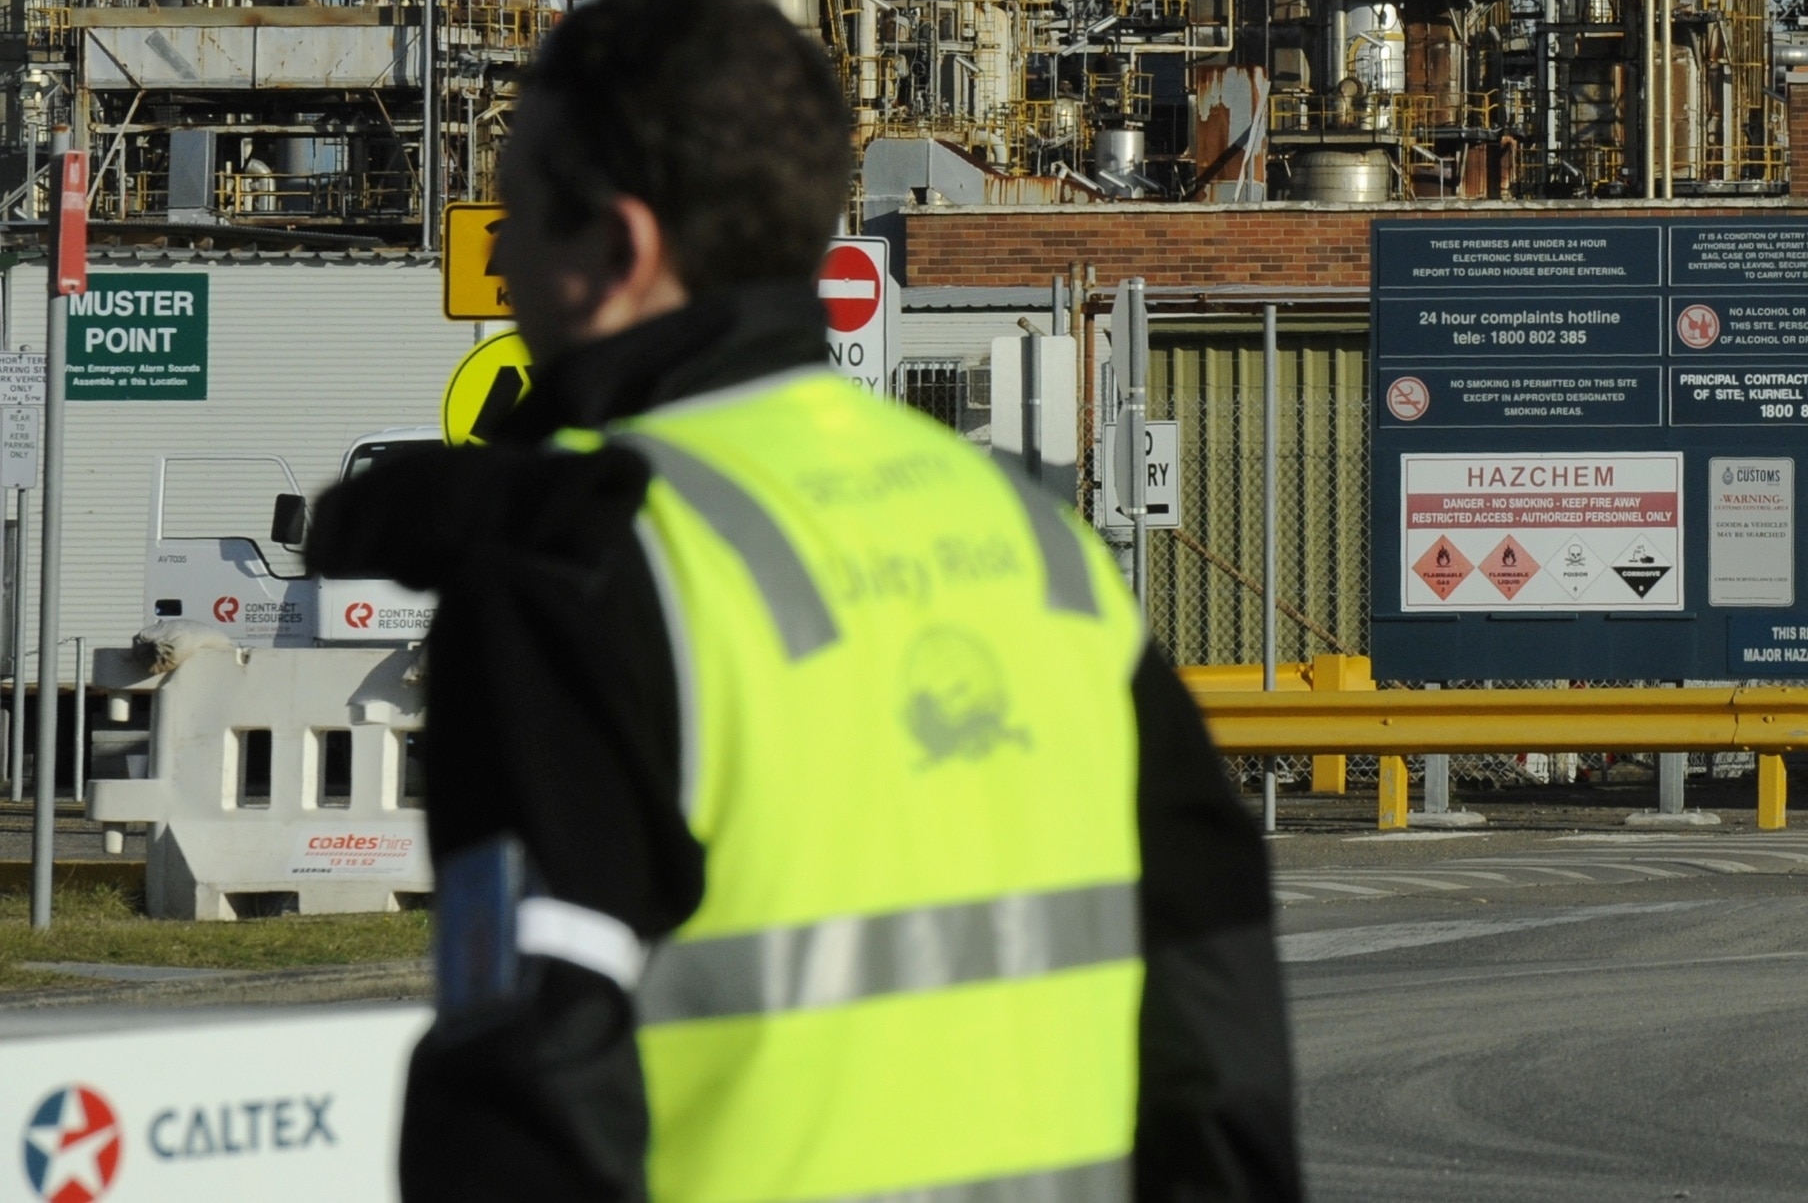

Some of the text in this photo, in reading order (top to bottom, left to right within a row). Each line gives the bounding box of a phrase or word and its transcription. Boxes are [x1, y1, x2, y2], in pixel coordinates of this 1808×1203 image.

[1431, 239, 1606, 249] THESE PREMISES ARE UNDER 24 HOUR
[1453, 254, 1586, 262] ELECTRONIC SURVEILLANCE.
[1413, 267, 1626, 277] REPORT TO GUARD HOUSE BEFORE ENTERING.
[70, 291, 194, 316] MUSTER
[1729, 307, 1743, 316] NO
[1745, 307, 1789, 316] ALCOHOL
[1792, 307, 1805, 316] OR
[1419, 310, 1620, 327] 24 hour complaints hotline
[1730, 322, 1751, 330] THIS
[85, 328, 177, 353] POINT
[1453, 330, 1586, 344] tele: 1800 802 385
[1720, 336, 1732, 344] OF
[1735, 335, 1780, 344] ALCOHOL
[1782, 335, 1795, 344] OR
[88, 364, 200, 374] Emergency Alarm Sounds
[73, 377, 187, 386] Assemble at this Location
[1451, 379, 1637, 388] NO SMOKING IS PERMITTED ON THIS SITE
[1680, 374, 1739, 385] PRINCIPAL
[1463, 393, 1625, 402] EXCEPT IN APPROVED DESIGNATED
[1694, 389, 1709, 400] OF
[1749, 389, 1802, 400] KURNELL
[1504, 407, 1583, 416] SMOKING AREAS.
[1760, 405, 1793, 417] 1800
[1467, 466, 1615, 487] HAZCHEM
[1737, 469, 1780, 482] CUSTOMS
[1443, 497, 1641, 509] DANGER NO SMOKING KEEP FIRE AWAY
[1412, 512, 1672, 523] RESTRICTED ACCESS AUTHORIZED PERSONNEL ONLY
[245, 603, 296, 613] CONTRACT
[245, 613, 302, 623] RESOURCES
[379, 619, 430, 628] RESOURC
[1772, 627, 1796, 640] THIS
[1744, 648, 1781, 661] MAJOR
[147, 1093, 338, 1160] CALTEX
